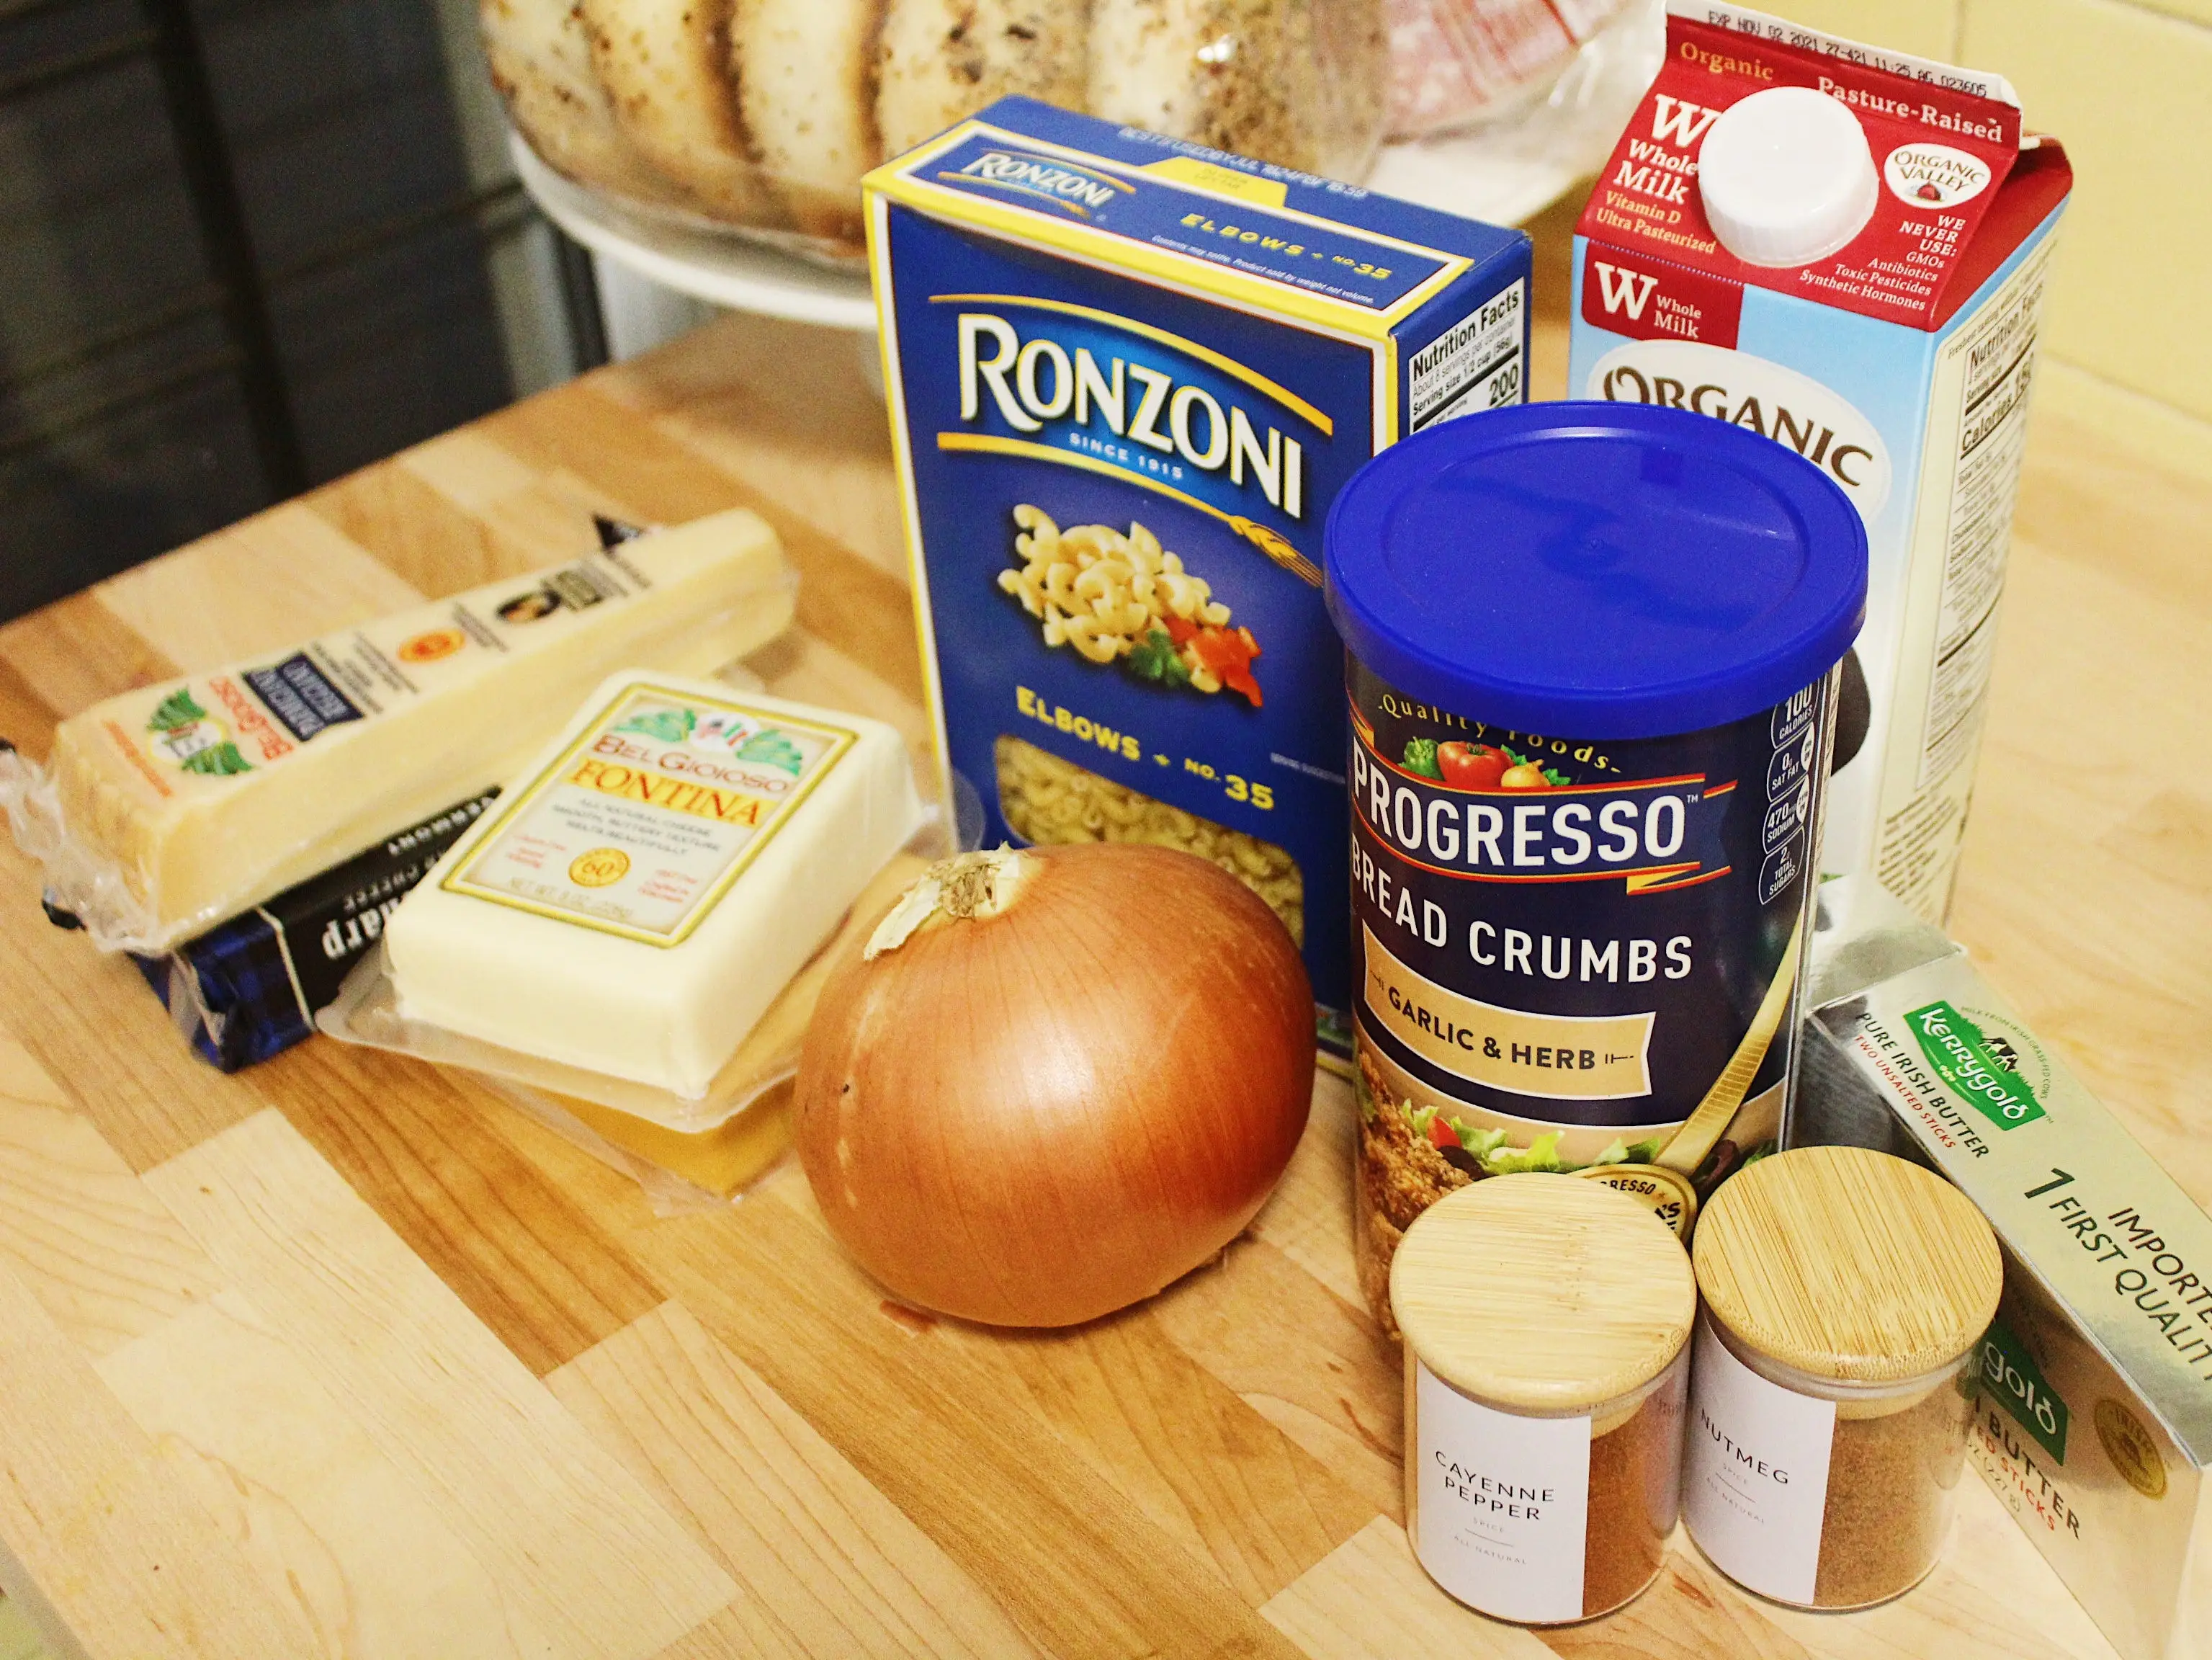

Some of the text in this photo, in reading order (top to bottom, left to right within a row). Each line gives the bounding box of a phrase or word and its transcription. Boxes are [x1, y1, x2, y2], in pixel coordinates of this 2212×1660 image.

[1708, 9, 1731, 28] EXP
[1790, 30, 1819, 52] 2021
[1679, 40, 1775, 81] Organic
[1652, 93, 1724, 148] W
[1817, 75, 2004, 144] Pasture-Raised
[960, 151, 1116, 208] RONZONI
[1628, 138, 1698, 176] Whole
[1894, 150, 1986, 184] ORGANIC
[1899, 166, 1971, 192] VALLEY
[1613, 159, 1690, 205] Milk
[1606, 189, 1682, 224] Vitamin D
[1938, 214, 1967, 231] WE
[1180, 213, 1393, 280] ELBOWS NO. 35
[1595, 208, 1718, 254] Ultra Pasteurized
[1898, 220, 1959, 244] NEVER
[1919, 238, 1958, 257] USE:
[1152, 234, 1188, 251] Contents
[1232, 257, 1267, 275] Product
[1266, 267, 1285, 279] sold
[1284, 272, 1298, 282] by
[1297, 275, 1327, 291] weight
[1326, 282, 1342, 295] not
[1835, 263, 1933, 297] Toxic Pesticides
[1867, 257, 1939, 282] Antibiotics
[1905, 251, 1945, 269] GMOs
[1594, 260, 1702, 321] W Whole
[1799, 269, 1927, 311] Synthetic Hormones
[1413, 289, 1520, 382] Nutrition Facts
[1654, 309, 1700, 340] Milk
[1969, 311, 2020, 370] Nutrition
[1412, 374, 1435, 399] About
[1441, 348, 1471, 380] servings
[1412, 385, 1443, 416] Serving
[1445, 373, 1461, 393] size
[1464, 364, 1476, 379] 1/2
[1476, 349, 1492, 368] cup
[1489, 362, 1520, 406] 200
[958, 312, 1302, 519] RONZONI
[1603, 365, 1873, 488] ORGANIC
[1961, 393, 2012, 452] Calories
[1070, 432, 1184, 481] SINCE 1915
[1382, 693, 1487, 738] Quality
[1778, 704, 1813, 740] CALORIES
[1785, 683, 1813, 722] 100
[1016, 685, 1275, 811] ELBOWS NO. 35
[569, 759, 763, 826] FONTINA
[1771, 760, 1800, 791] SAT FAT
[604, 803, 658, 824] NATURAL
[1352, 737, 1685, 867] PROGRESSO
[1686, 793, 1699, 804] TM
[1767, 813, 1796, 844] SODIUM
[1768, 865, 1796, 896] SUGARS
[1774, 857, 1793, 880] TOTAL
[322, 898, 400, 960] arp
[1351, 830, 1693, 983] BREAD CRUMBS
[1388, 986, 1596, 1070] GARLIC & HERB
[1984, 1011, 2010, 1027] FROM
[2010, 1024, 2030, 1041] IRISH
[1855, 1012, 1990, 1159] PURE IRISH BUTTER
[1918, 1007, 2030, 1120] Kerrygold
[1853, 1034, 1956, 1149] TWO UNSALTED STICKS
[2024, 1167, 2076, 1199] 1
[2048, 1196, 2128, 1263] FIRST
[2108, 1207, 2212, 1338] IMPORTE
[1701, 1407, 1789, 1485] NUTMEG
[1435, 1450, 1555, 1503] CAYENNE
[1444, 1475, 1541, 1521] PEPPER
[1989, 1411, 2080, 1541] BUTTER
[2000, 1456, 2055, 1532] STICKS
[1472, 1516, 1505, 1534] SPICE
[1721, 1491, 1765, 1525] NATURAL
[1453, 1534, 1528, 1566] ALL NATURAL
